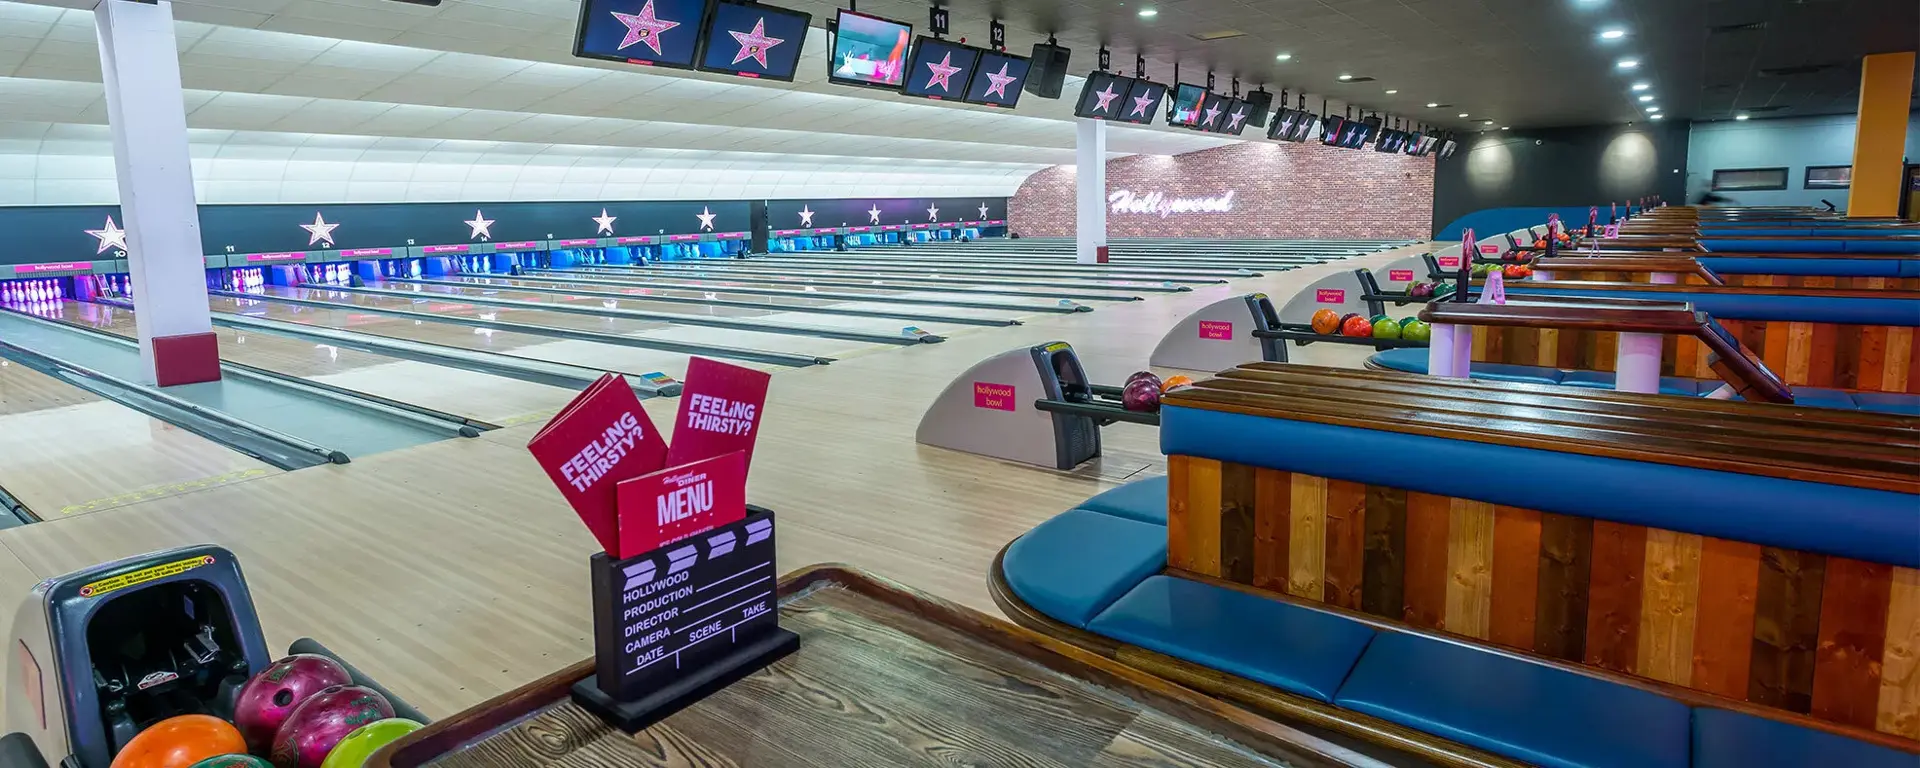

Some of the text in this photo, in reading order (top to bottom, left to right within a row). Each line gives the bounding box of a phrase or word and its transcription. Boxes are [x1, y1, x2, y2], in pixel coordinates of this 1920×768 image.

[935, 13, 946, 29] 11
[993, 27, 1003, 42] 12
[1101, 53, 1109, 66] 13
[1109, 190, 1234, 219] Hollywood
[114, 250, 127, 258] 10
[1201, 323, 1230, 331] hollywood
[977, 385, 1012, 397] hollywood
[986, 397, 1003, 407] bowl
[687, 411, 752, 437] THIRSTY?
[570, 425, 644, 493] THIRSTY?
[678, 473, 707, 487] DINER
[656, 480, 713, 527] MENU
[98, 578, 120, 588] Caution
[623, 571, 689, 604] HOLLYWOOD
[624, 585, 693, 621] PRODUCTION
[624, 606, 679, 638] DIRECTOR
[625, 627, 671, 653] CAMERA
[636, 600, 766, 666] DATE SCENE TAKE
